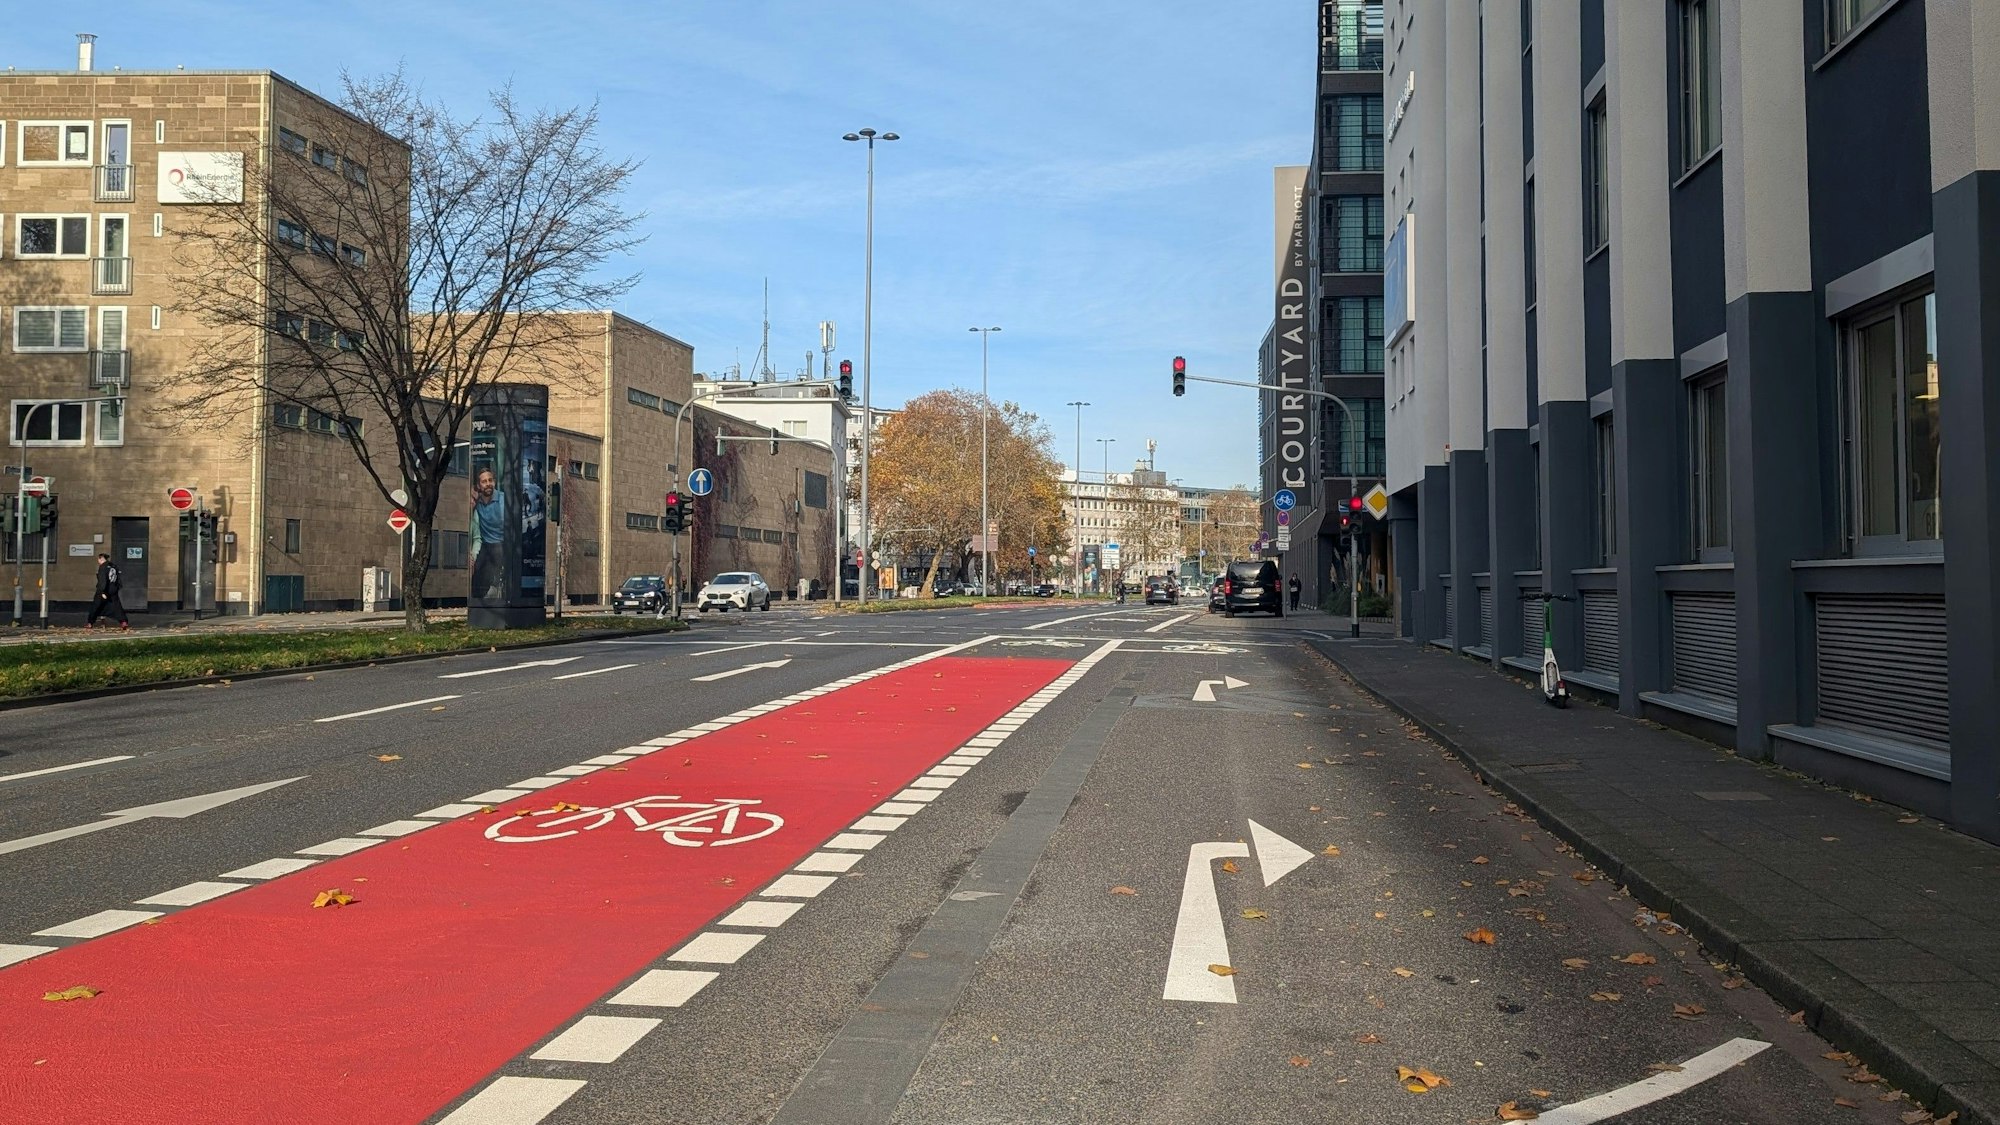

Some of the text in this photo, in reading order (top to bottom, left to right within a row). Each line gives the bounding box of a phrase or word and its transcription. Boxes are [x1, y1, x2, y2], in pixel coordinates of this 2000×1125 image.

[1294, 185, 1303, 247] MARRIOTT
[1294, 252, 1303, 267] BY
[1281, 278, 1305, 482] COURTYARD
